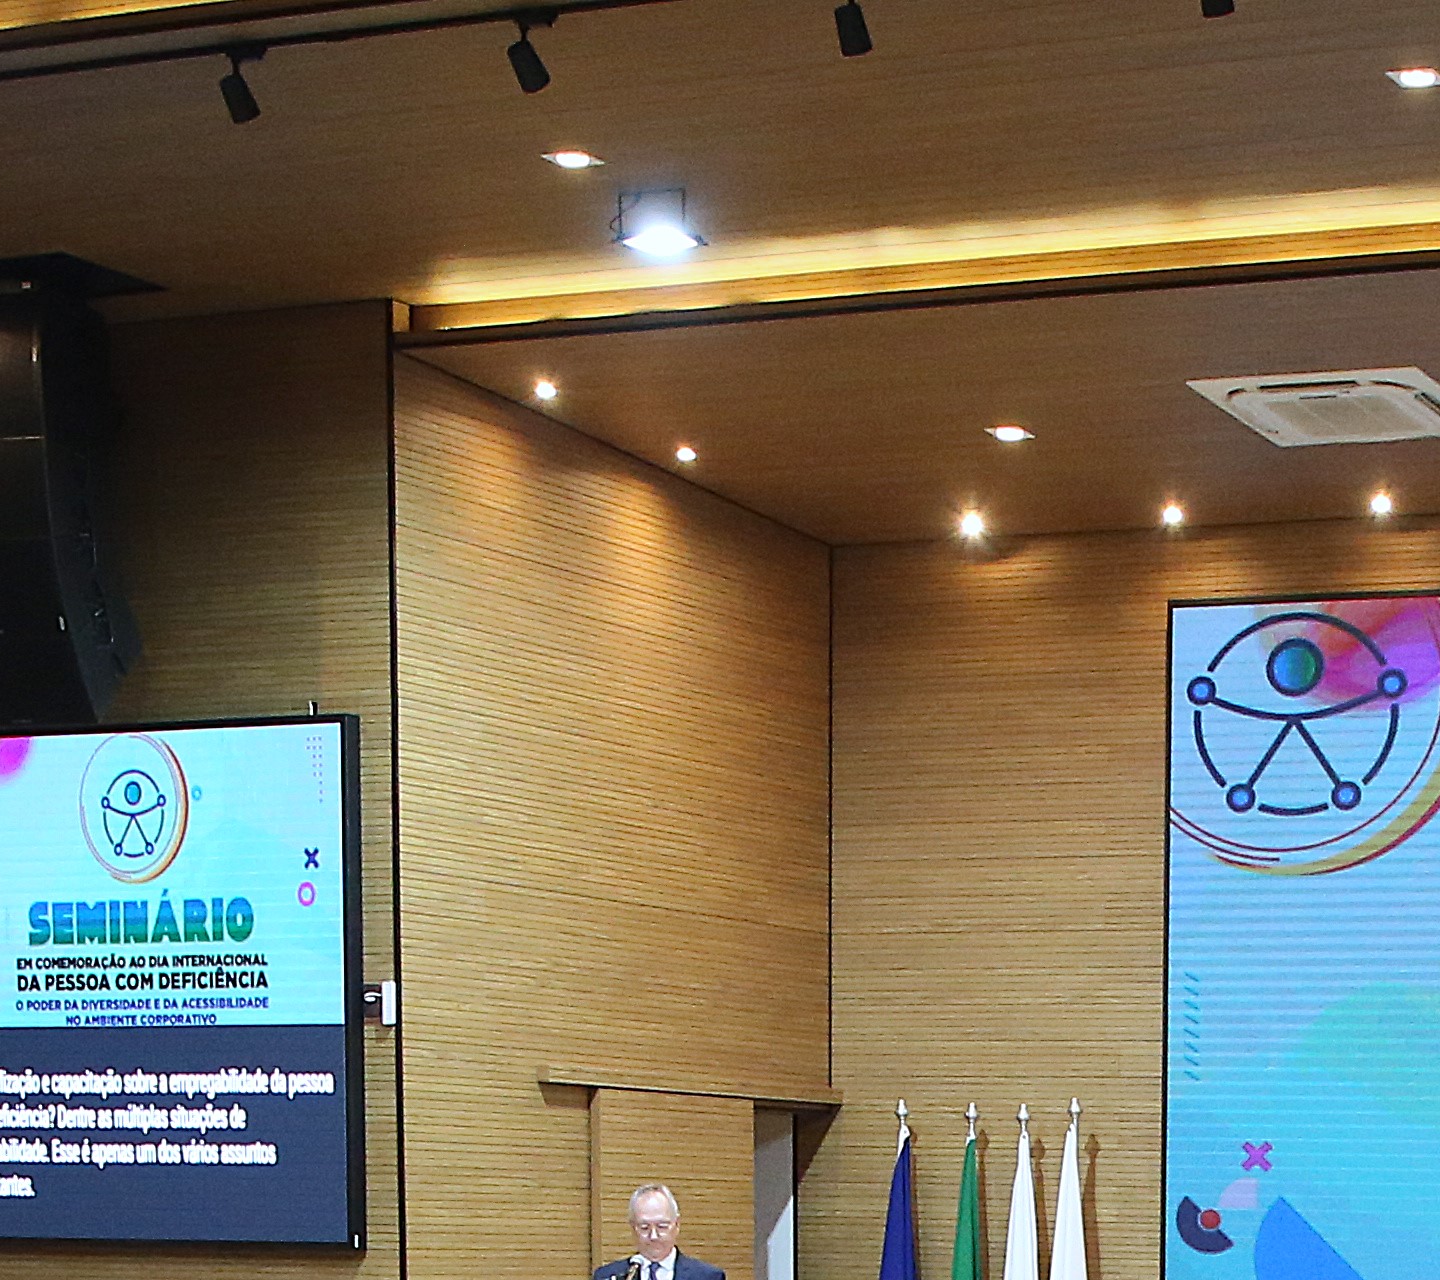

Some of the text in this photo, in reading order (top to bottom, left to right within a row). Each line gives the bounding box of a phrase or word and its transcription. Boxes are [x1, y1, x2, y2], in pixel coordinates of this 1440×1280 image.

[29, 889, 255, 945] SEMINÁRIO
[17, 954, 268, 970] EM COMEMORAÇÃO AO DIA INTERNACIONAL
[18, 967, 268, 991] DA PESSOA COM DEFICIÊNCIA
[16, 998, 269, 1010] O PODER DA DIVERSIDADE E DA ACESSIBILIDADE
[66, 1015, 217, 1026] NO AMBIENTE CORPORATIVO
[41, 1074, 50, 1094] e
[51, 1068, 122, 1099] capacitação
[123, 1068, 158, 1094] sobre
[159, 1073, 168, 1093] a
[169, 1067, 269, 1099] empregabilidade
[270, 1067, 287, 1093] da
[288, 1073, 334, 1099] pessoa
[57, 1104, 96, 1128] Dentre
[97, 1109, 112, 1128] as
[113, 1103, 168, 1134] múltiplas
[170, 1103, 228, 1134] situações
[229, 1103, 247, 1129] de
[51, 1138, 80, 1163] Esse
[81, 1138, 90, 1163] é
[91, 1144, 135, 1169] apenas
[136, 1144, 156, 1163] um
[158, 1138, 181, 1164] dos
[182, 1138, 219, 1164] vários
[220, 1141, 277, 1164] assuntos
